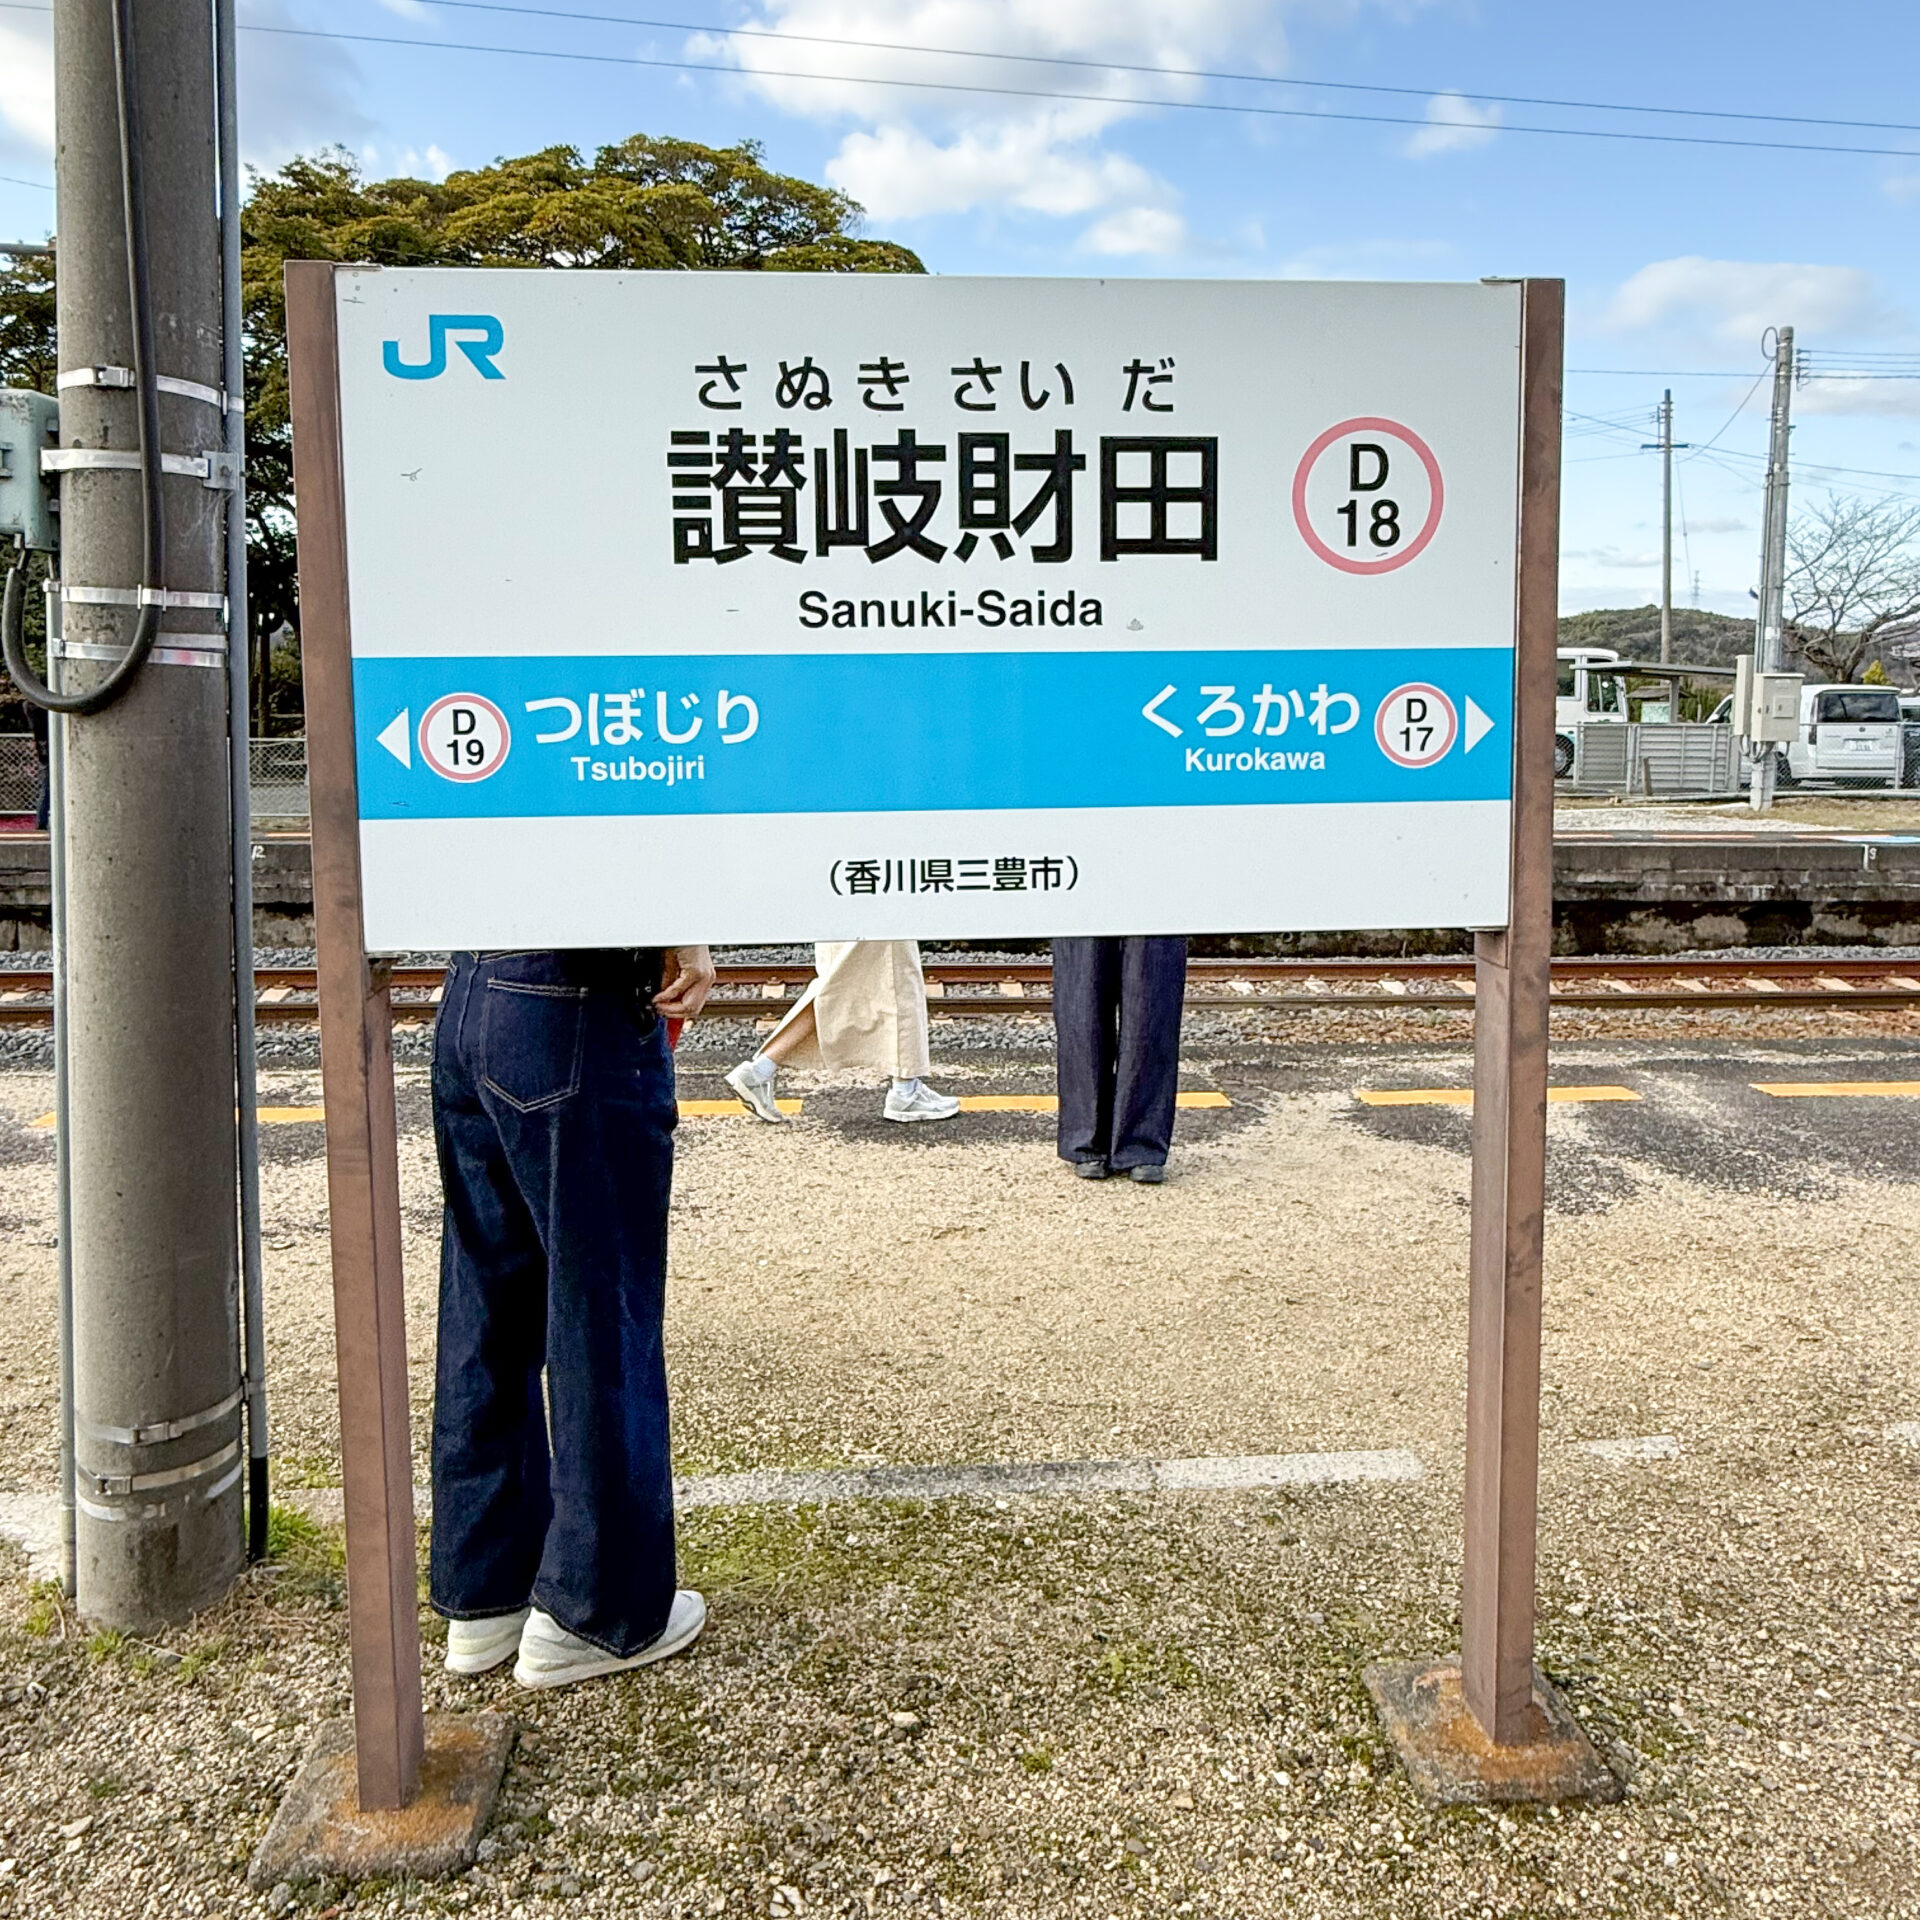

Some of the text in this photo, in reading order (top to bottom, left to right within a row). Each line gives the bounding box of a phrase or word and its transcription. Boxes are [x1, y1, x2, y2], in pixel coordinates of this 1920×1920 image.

[383, 315, 506, 380] JR
[694, 355, 1176, 412] さぬきさいだ
[1350, 443, 1390, 492] D
[1337, 499, 1401, 548] 18
[799, 589, 1104, 629] Sanuki-Saida
[452, 709, 476, 735] D
[524, 688, 760, 746] つぼじり
[1141, 683, 1361, 738] くろかわ
[1406, 698, 1427, 724] D
[447, 739, 485, 766] 19
[1185, 747, 1326, 772] Kurokawa
[1399, 727, 1434, 752] 17
[570, 755, 706, 787] Tsubojiri
